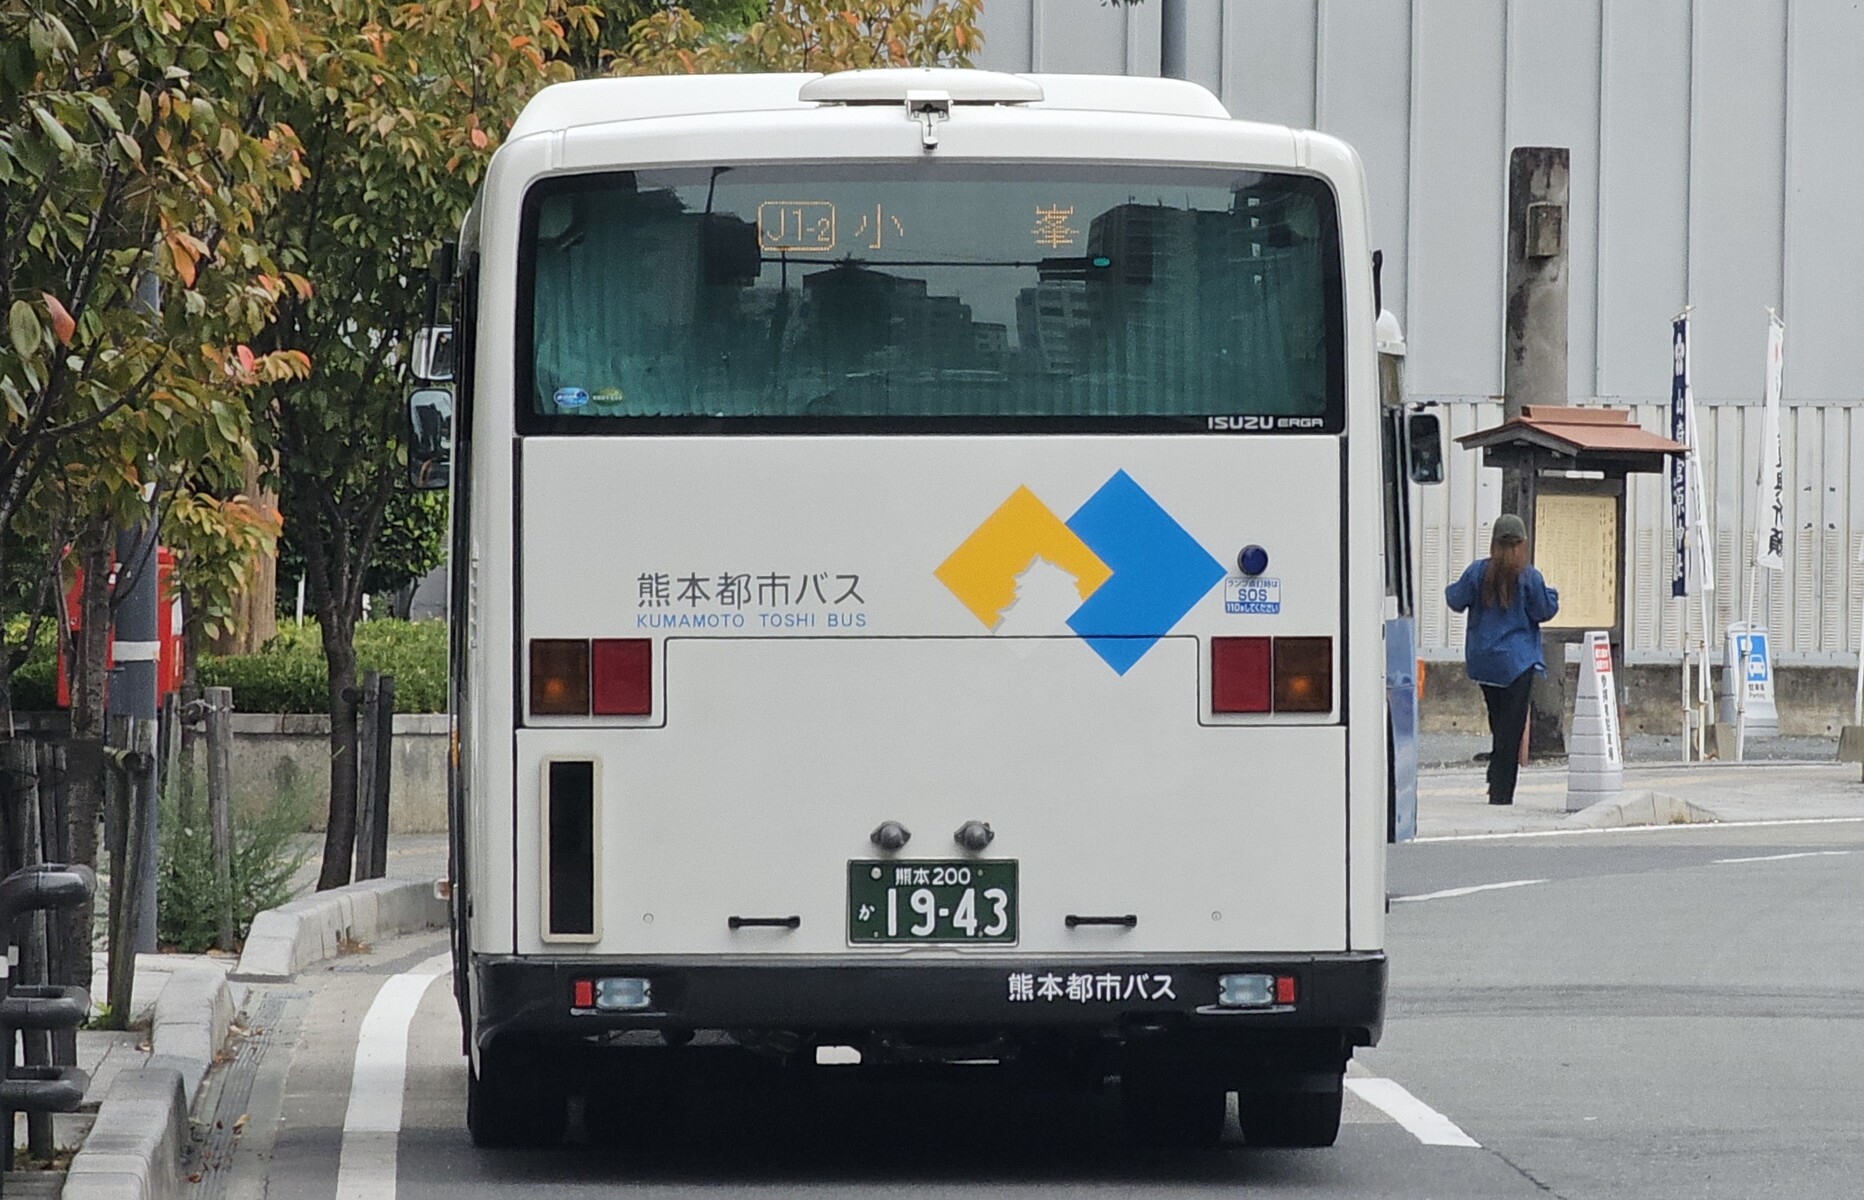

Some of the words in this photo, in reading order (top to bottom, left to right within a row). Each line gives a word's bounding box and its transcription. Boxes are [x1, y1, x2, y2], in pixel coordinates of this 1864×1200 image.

[766, 207, 830, 242] J1-2
[854, 203, 904, 249] 小
[1208, 416, 1274, 430] ISUZU
[1277, 417, 1324, 428] ERGA
[637, 571, 866, 610] 熊本都市バス
[1238, 588, 1268, 602] SOS
[637, 613, 744, 628] KUMAMOTO
[759, 613, 815, 628] TOSHI
[827, 613, 867, 628] BUS
[858, 904, 876, 921] か
[887, 888, 1008, 937] 19-43
[1007, 972, 1176, 1004] 熊本都市バス
